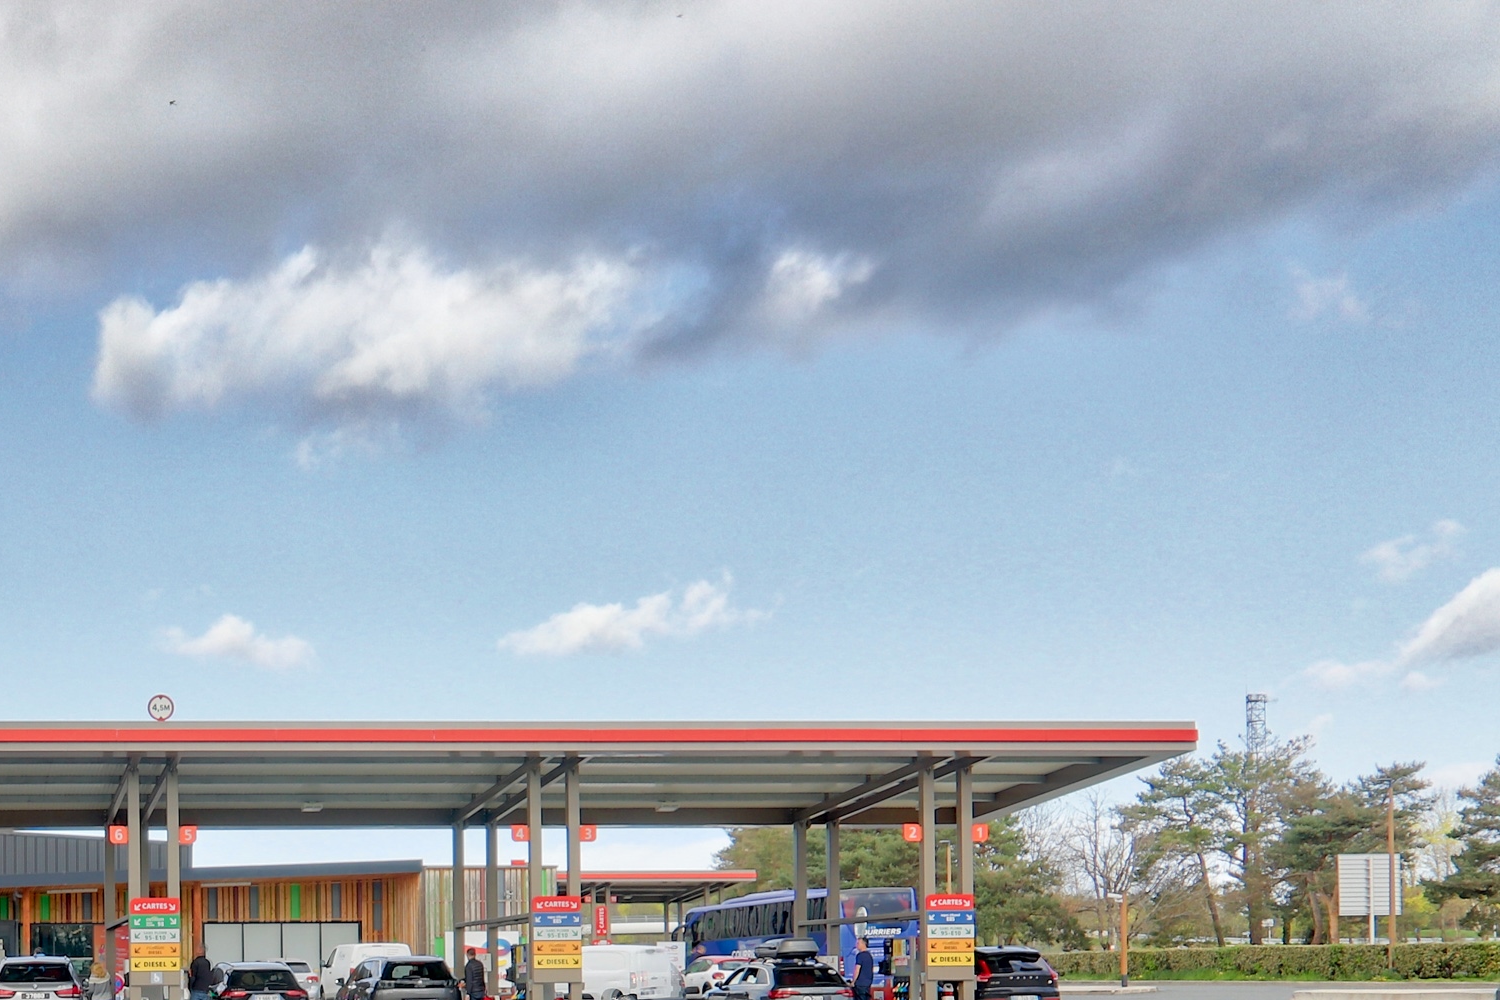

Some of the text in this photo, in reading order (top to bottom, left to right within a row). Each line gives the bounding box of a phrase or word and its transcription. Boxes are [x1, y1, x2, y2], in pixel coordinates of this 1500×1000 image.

[115, 829, 123, 839] 6
[185, 829, 192, 839] 5
[516, 828, 524, 838] 4
[585, 828, 592, 838] 3
[909, 827, 917, 839] 2
[977, 827, 983, 838] 1
